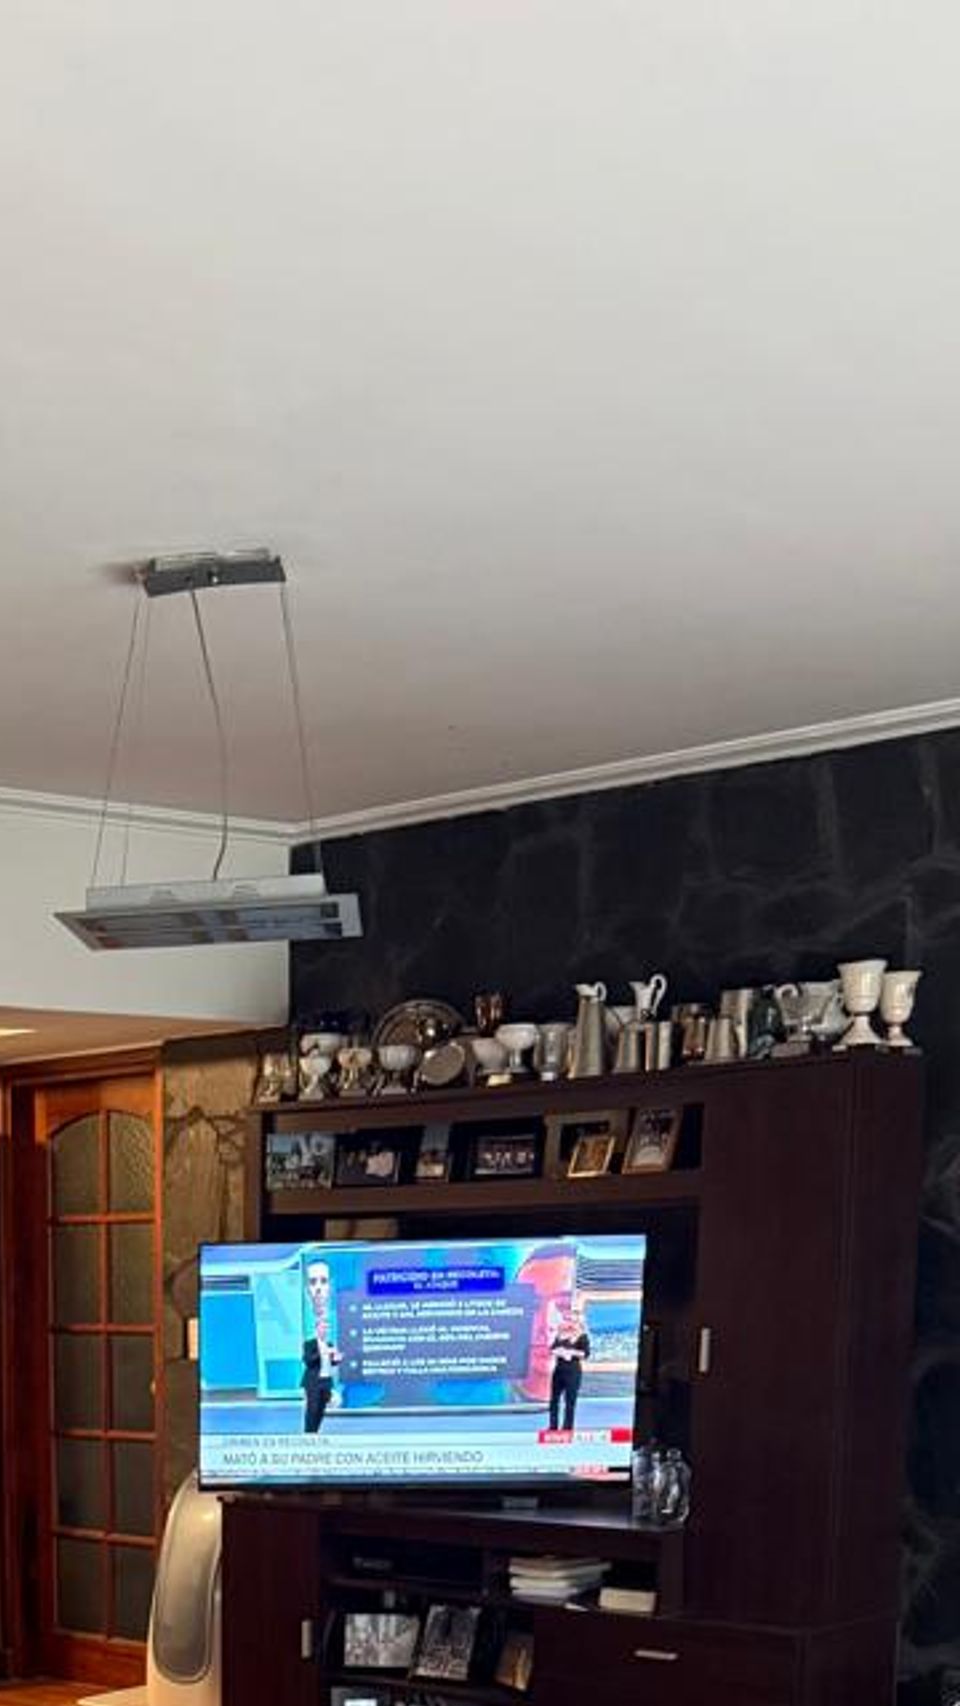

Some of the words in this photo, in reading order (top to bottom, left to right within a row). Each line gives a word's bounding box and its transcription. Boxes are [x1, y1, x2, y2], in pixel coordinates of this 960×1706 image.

[223, 1449, 257, 1466] MATÓ
[259, 1452, 269, 1466] A
[271, 1452, 289, 1466] SU
[291, 1452, 330, 1465] PADRE
[336, 1452, 362, 1465] CON
[366, 1450, 409, 1464] ACEITE
[413, 1450, 484, 1463] HIRVIENDO
